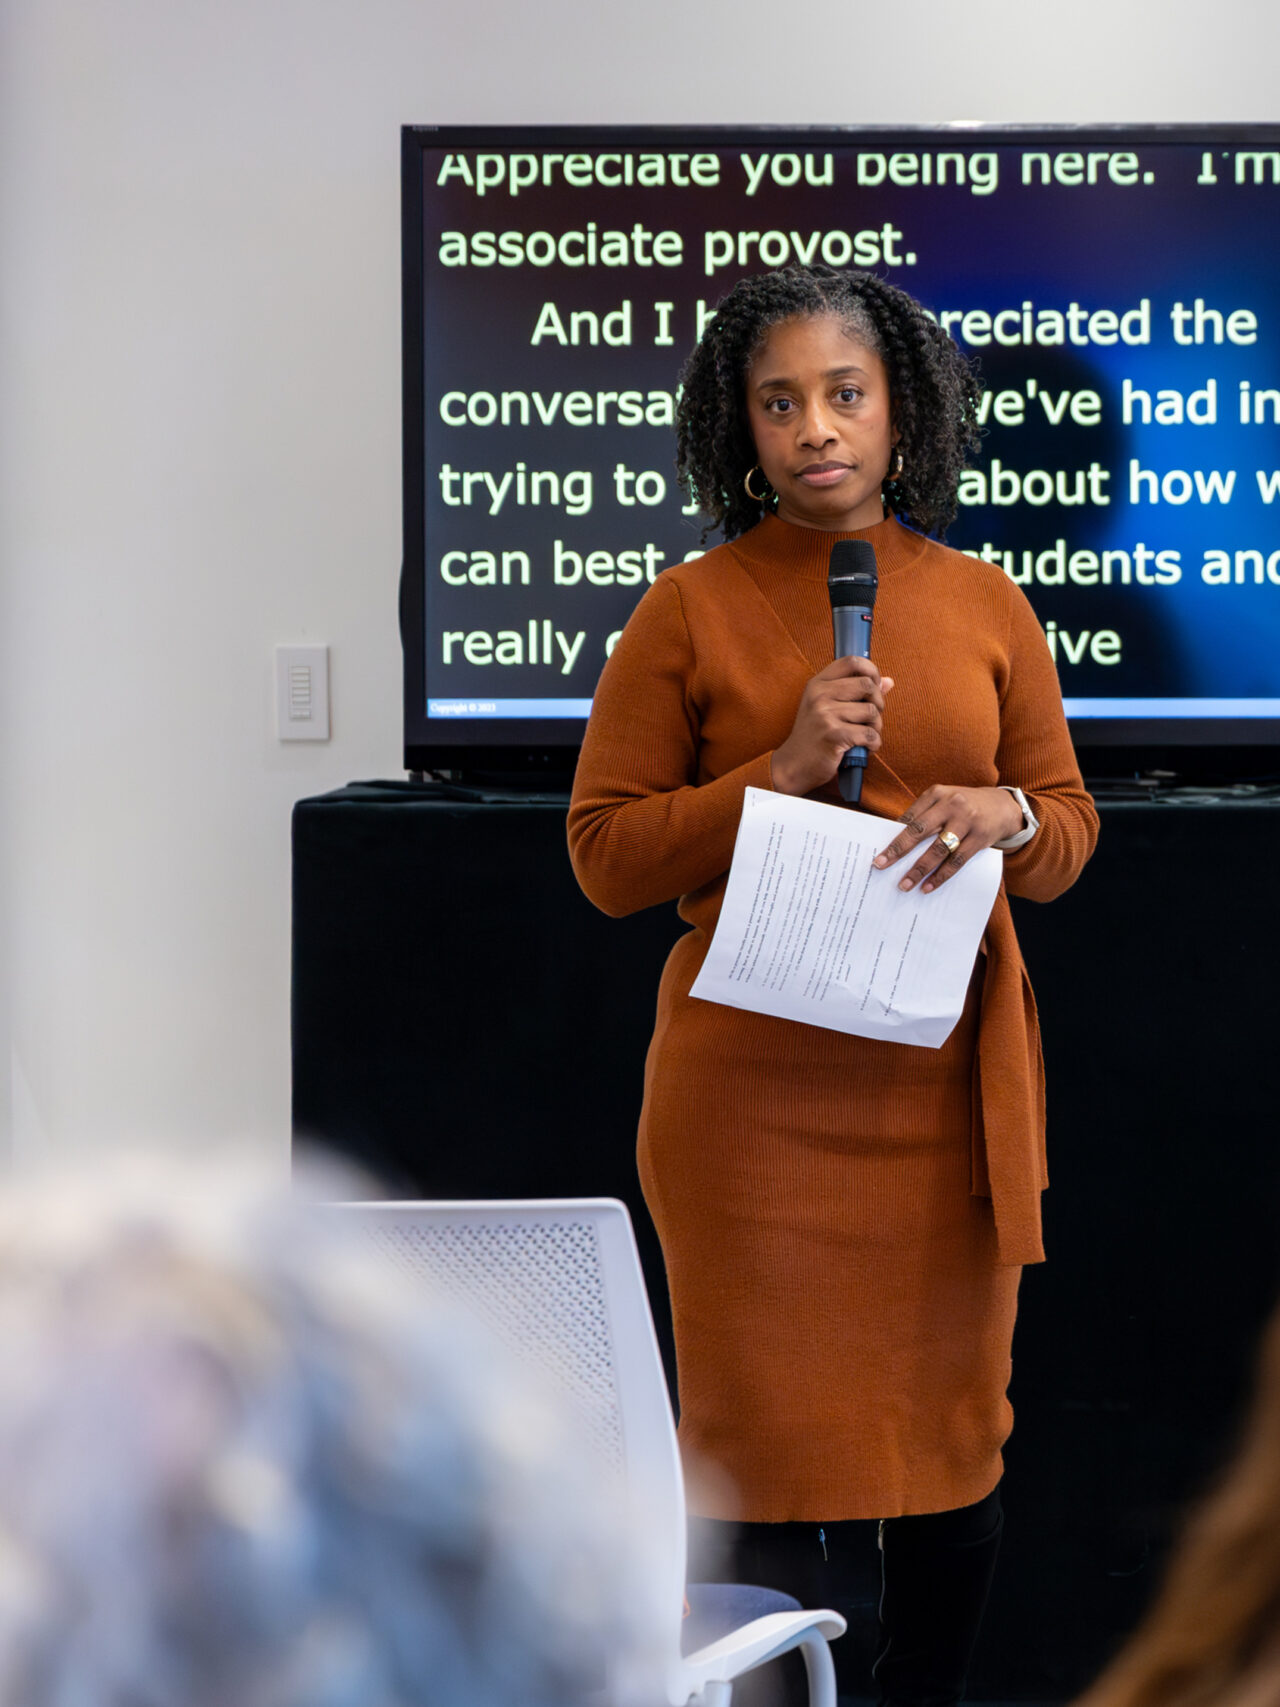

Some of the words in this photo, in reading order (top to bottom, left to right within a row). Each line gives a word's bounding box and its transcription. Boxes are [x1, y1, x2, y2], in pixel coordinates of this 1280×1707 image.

[437, 152, 721, 197] Appreciate
[740, 154, 833, 196] you
[857, 152, 997, 196] being
[1022, 152, 1155, 186] here.
[438, 222, 684, 267] associate
[704, 222, 917, 276] provost.
[530, 298, 633, 346] And
[654, 302, 674, 346] I
[922, 298, 1151, 346] reciated
[1170, 298, 1258, 345] the
[439, 386, 684, 426] conversa
[1122, 378, 1217, 425] had
[438, 462, 593, 516] trying
[613, 463, 666, 506] to
[958, 459, 1110, 505] about
[1129, 459, 1237, 505] how
[440, 550, 530, 586] can
[553, 539, 665, 586] best
[960, 538, 1182, 586] tudents
[442, 619, 586, 676] really
